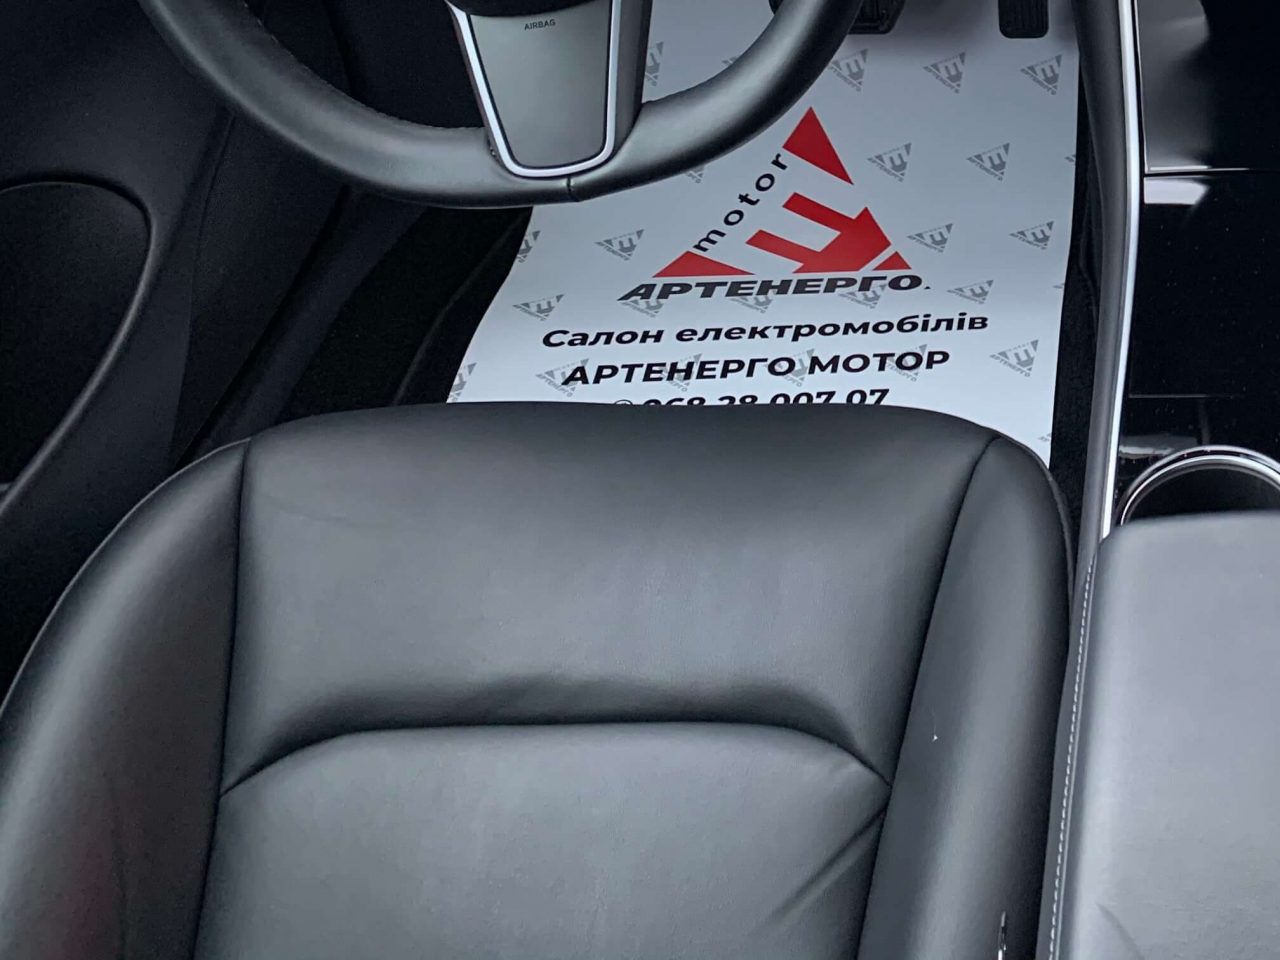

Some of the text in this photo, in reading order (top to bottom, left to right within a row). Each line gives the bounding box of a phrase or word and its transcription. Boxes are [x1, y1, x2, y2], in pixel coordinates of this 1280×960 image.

[524, 19, 556, 30] AIRBAG
[692, 152, 788, 253] motor
[542, 312, 988, 348] Салон електромобілів
[561, 356, 796, 386] АРТЕНЕРГО
[808, 350, 949, 376] МОТОР
[846, 389, 890, 405] 07
